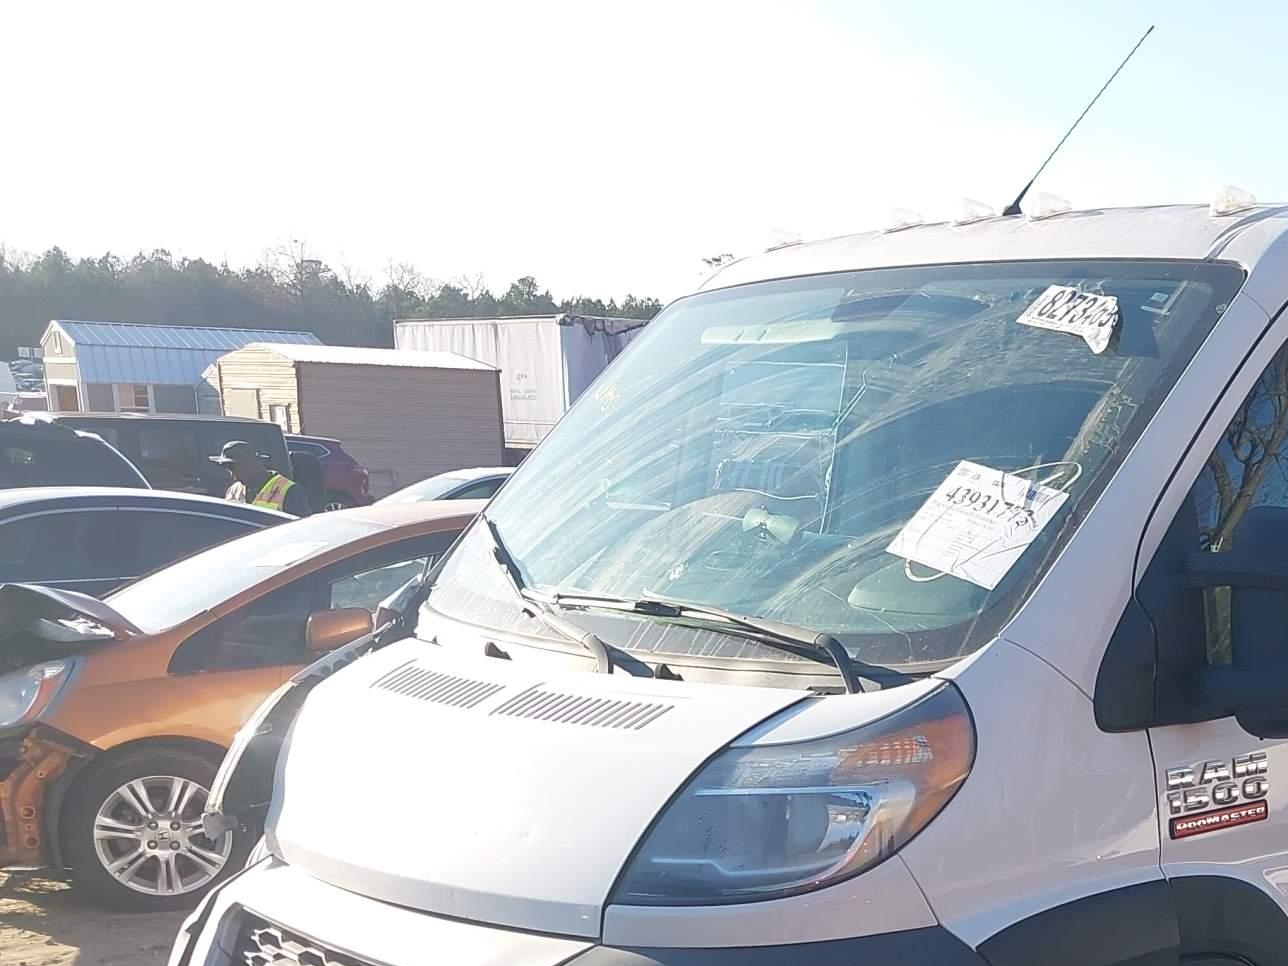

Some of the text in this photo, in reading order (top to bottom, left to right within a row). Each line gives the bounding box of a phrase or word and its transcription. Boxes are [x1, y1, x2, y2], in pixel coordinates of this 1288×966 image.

[945, 486, 1034, 527] 43931773
[1165, 751, 1268, 791] RAM
[1167, 776, 1269, 815] 1500
